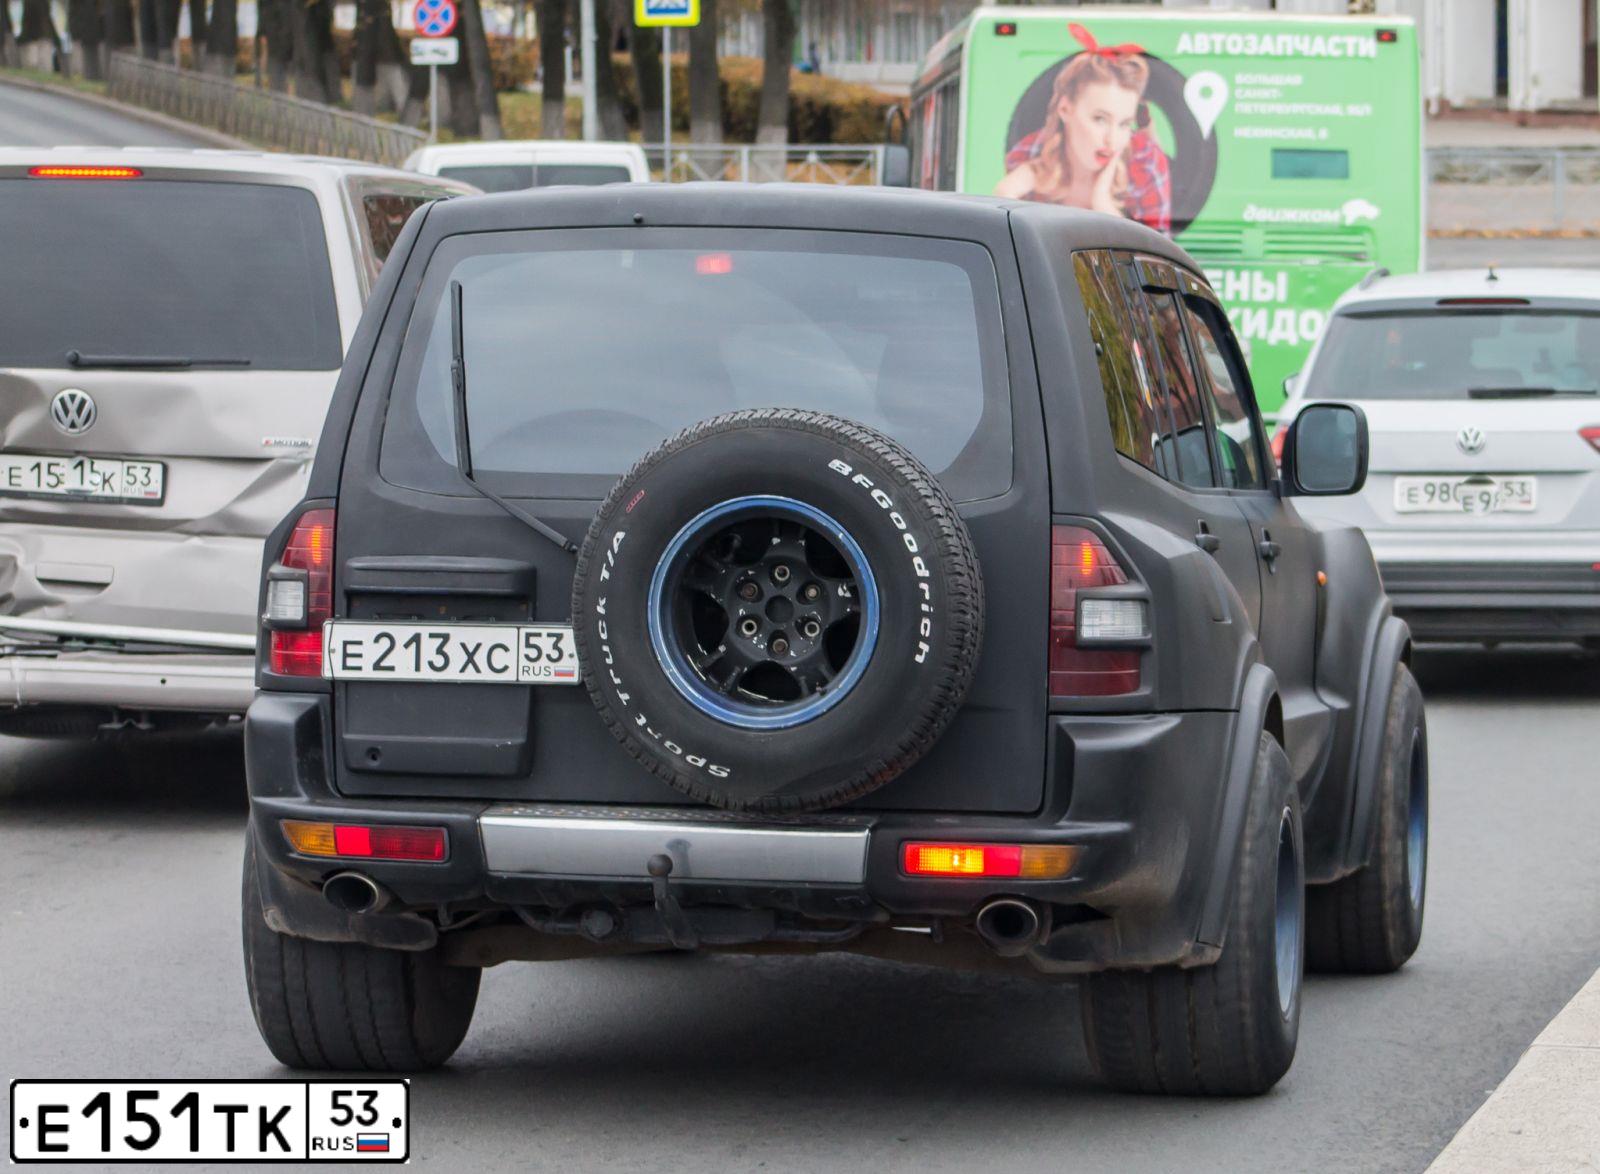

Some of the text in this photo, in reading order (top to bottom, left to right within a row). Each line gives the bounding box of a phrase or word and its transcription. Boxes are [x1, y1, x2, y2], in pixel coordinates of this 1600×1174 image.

[1177, 33, 1376, 57] АВТОЗАПЧАСТИ
[1203, 269, 1288, 303] ЕНЫ
[126, 465, 151, 487] 53
[827, 458, 934, 664] BFGoodrich
[342, 632, 564, 674] Е213ХС 53
[521, 665, 552, 677] RUS
[634, 712, 731, 778] Sport
